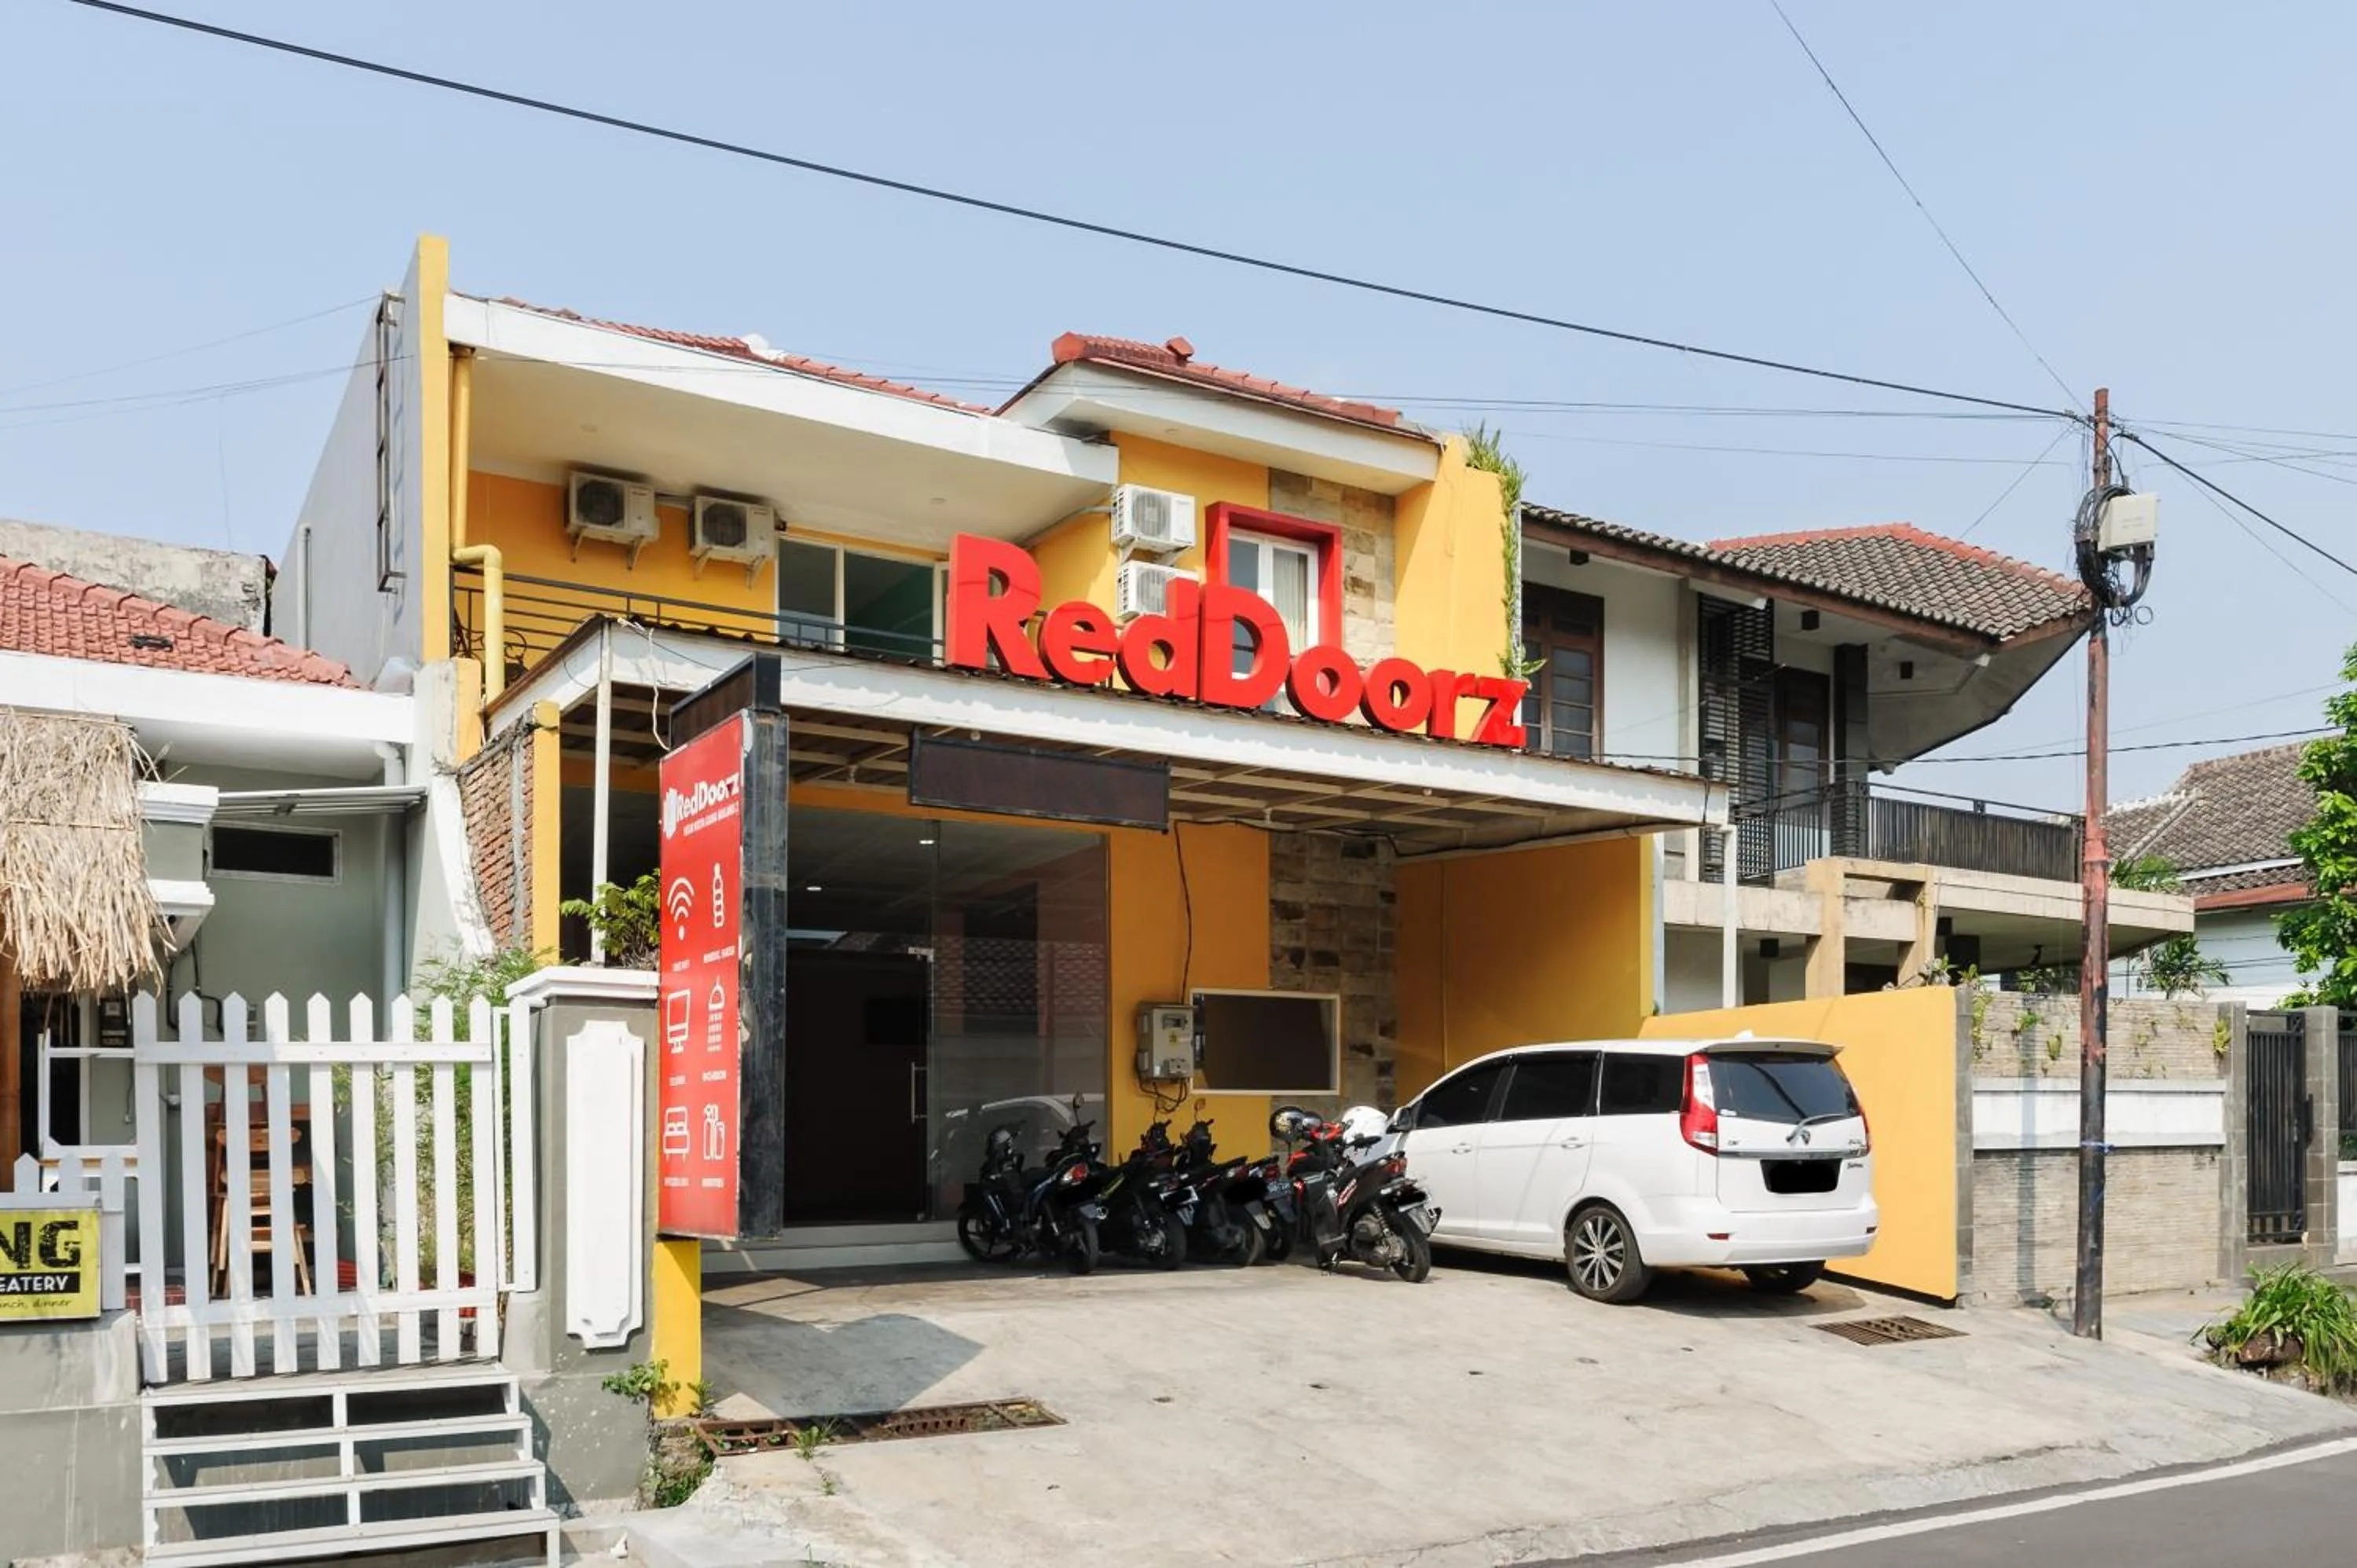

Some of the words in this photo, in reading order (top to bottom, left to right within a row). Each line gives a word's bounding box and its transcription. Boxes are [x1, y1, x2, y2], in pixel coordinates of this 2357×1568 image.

[946, 532, 1529, 748] RedDoorz
[676, 771, 739, 824] RedDoorz
[0, 1275, 68, 1292] EATERY
